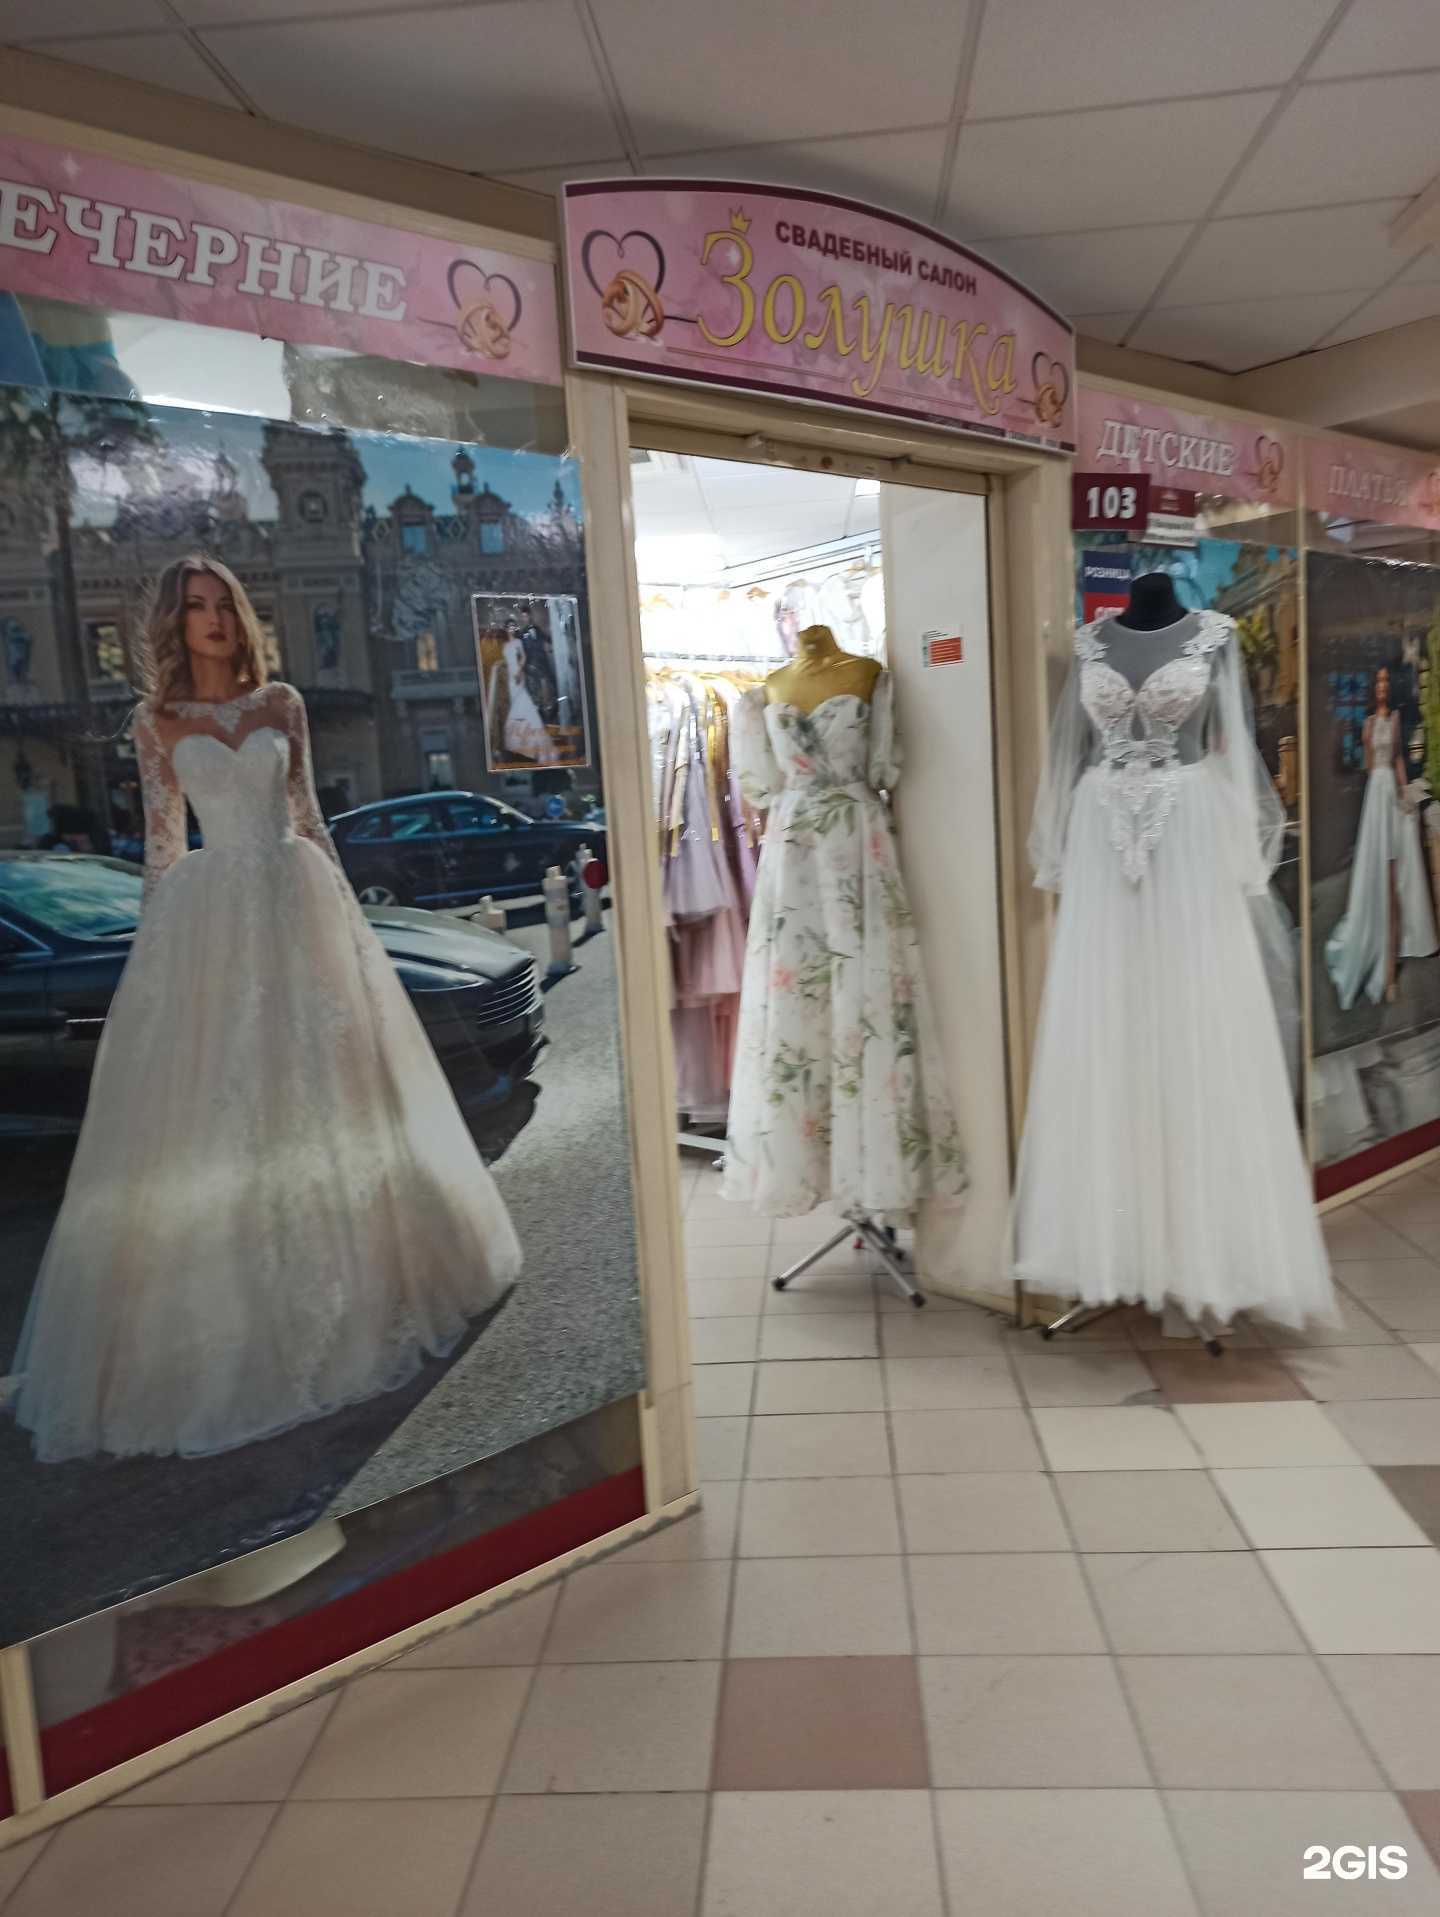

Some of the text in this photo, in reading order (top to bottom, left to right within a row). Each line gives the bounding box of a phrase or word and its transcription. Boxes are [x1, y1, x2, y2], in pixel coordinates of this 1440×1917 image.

[0, 178, 408, 322] ЕЧЕРНИЕ
[774, 220, 978, 296] СВАДЕБНЫЙ САЛОН
[697, 229, 1018, 416] Золушка
[1096, 418, 1234, 477] ДЕТСКИЕ
[1087, 486, 1138, 519] 103
